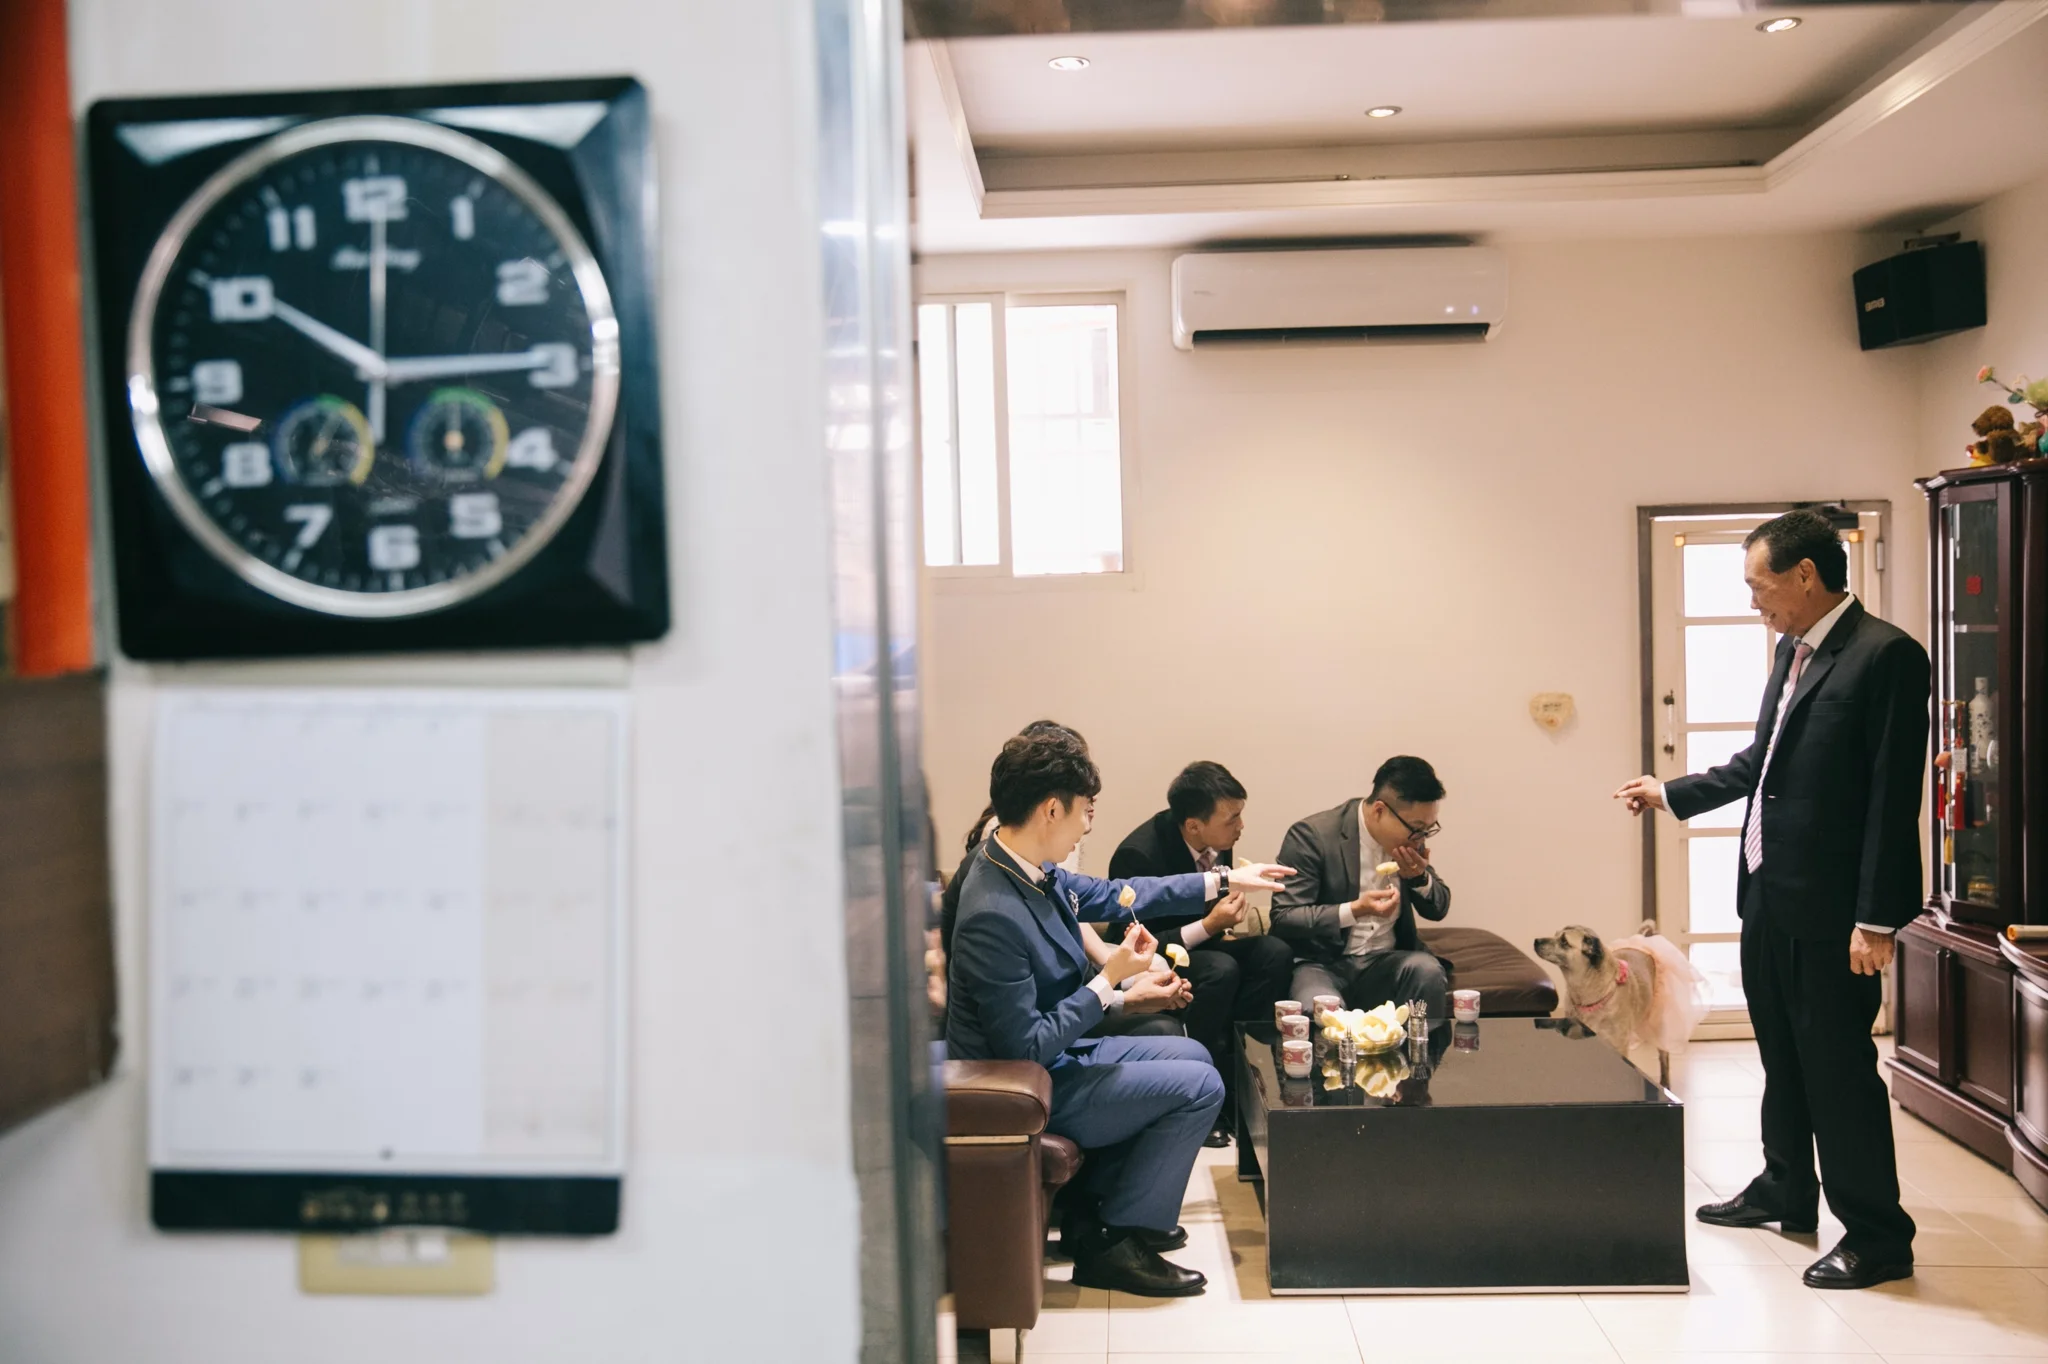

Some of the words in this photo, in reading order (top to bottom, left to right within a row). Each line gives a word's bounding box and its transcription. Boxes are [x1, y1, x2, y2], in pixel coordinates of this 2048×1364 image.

[343, 176, 409, 222] 12
[450, 195, 475, 241] 1
[266, 206, 317, 252] 11
[210, 276, 274, 322] 10
[496, 260, 550, 305] 2
[193, 360, 243, 403] 9
[530, 342, 578, 387] 3
[222, 442, 272, 487] 8
[507, 428, 557, 469] 4
[284, 503, 333, 550] 7
[449, 493, 502, 539] 5
[368, 524, 421, 571] 6
